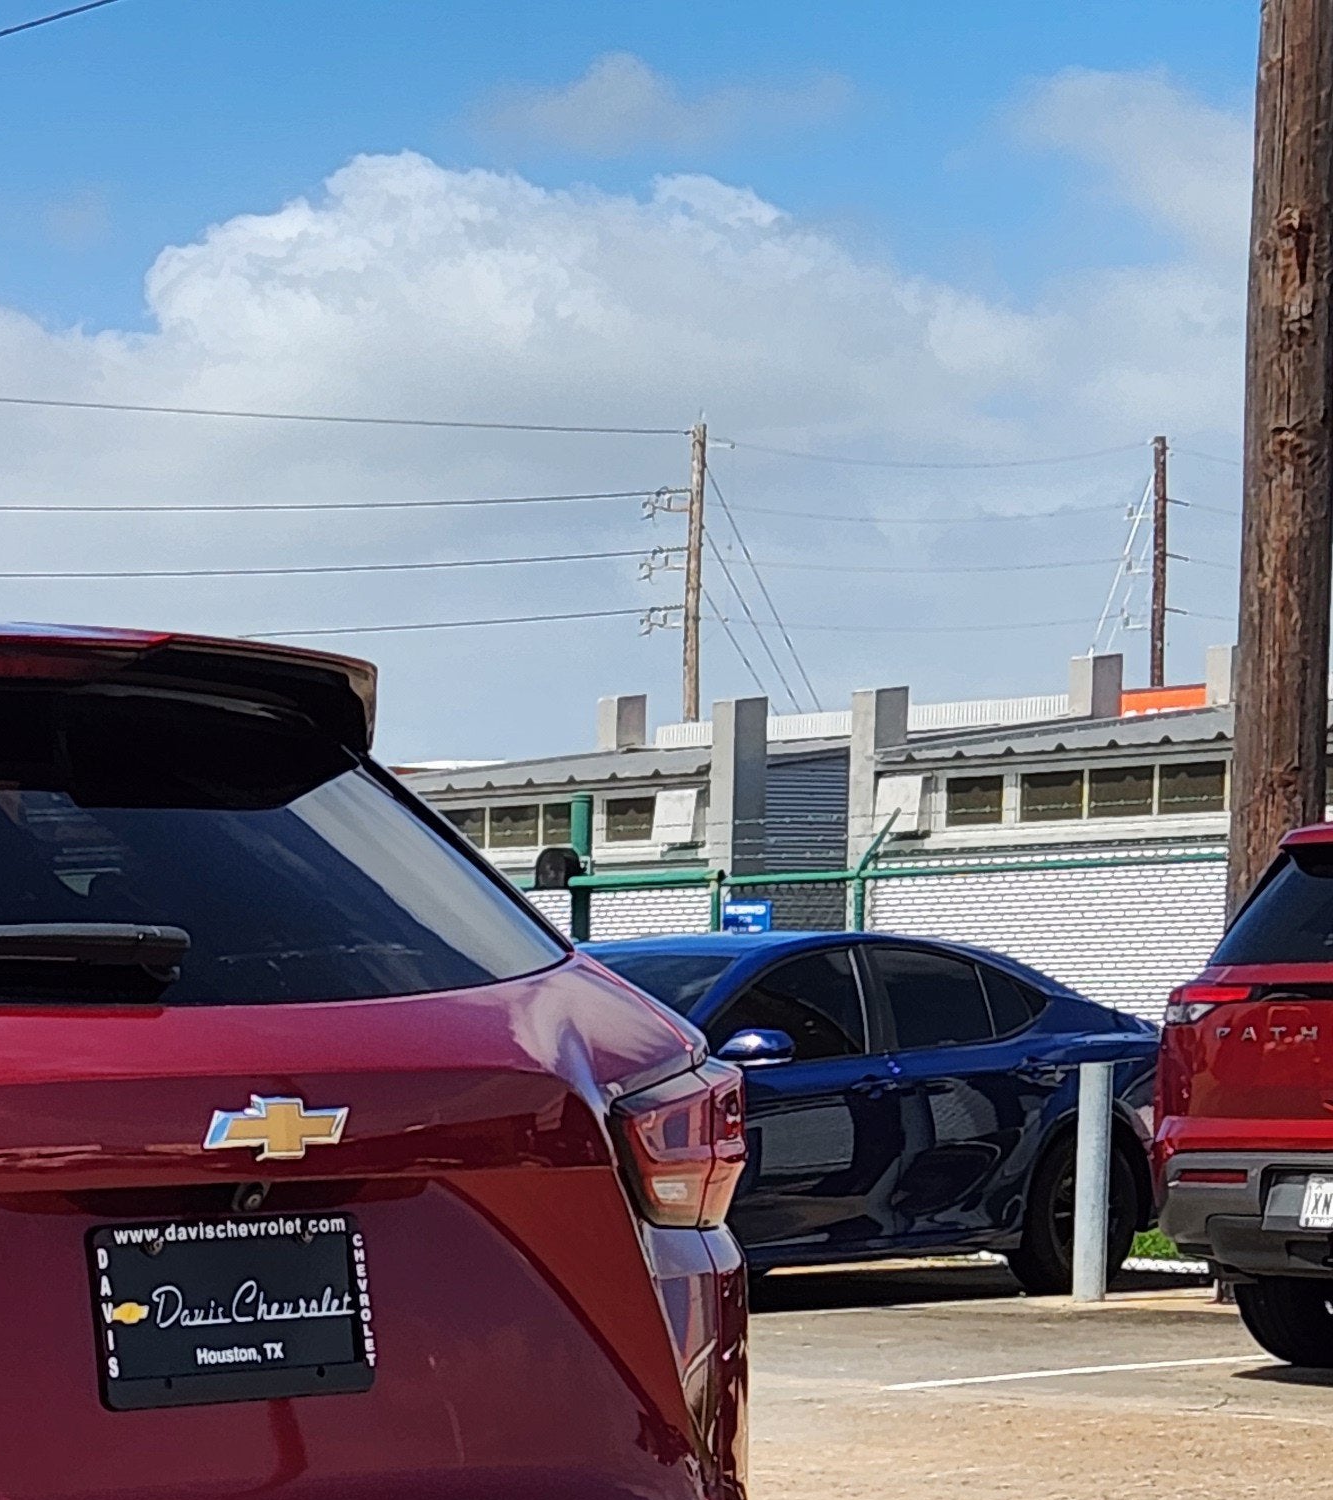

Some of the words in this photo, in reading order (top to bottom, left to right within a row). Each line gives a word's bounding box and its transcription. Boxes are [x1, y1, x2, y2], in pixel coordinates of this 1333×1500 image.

[1215, 1026, 1319, 1042] PATH
[113, 1217, 346, 1245] www.davischevroletcom
[96, 1247, 120, 1378] DAVIS
[152, 1285, 232, 1328] Davis
[232, 1280, 355, 1323] Chevrolet
[352, 1233, 376, 1367] CHEVROLET
[196, 1346, 262, 1366] Houston,
[263, 1342, 284, 1360] TX
